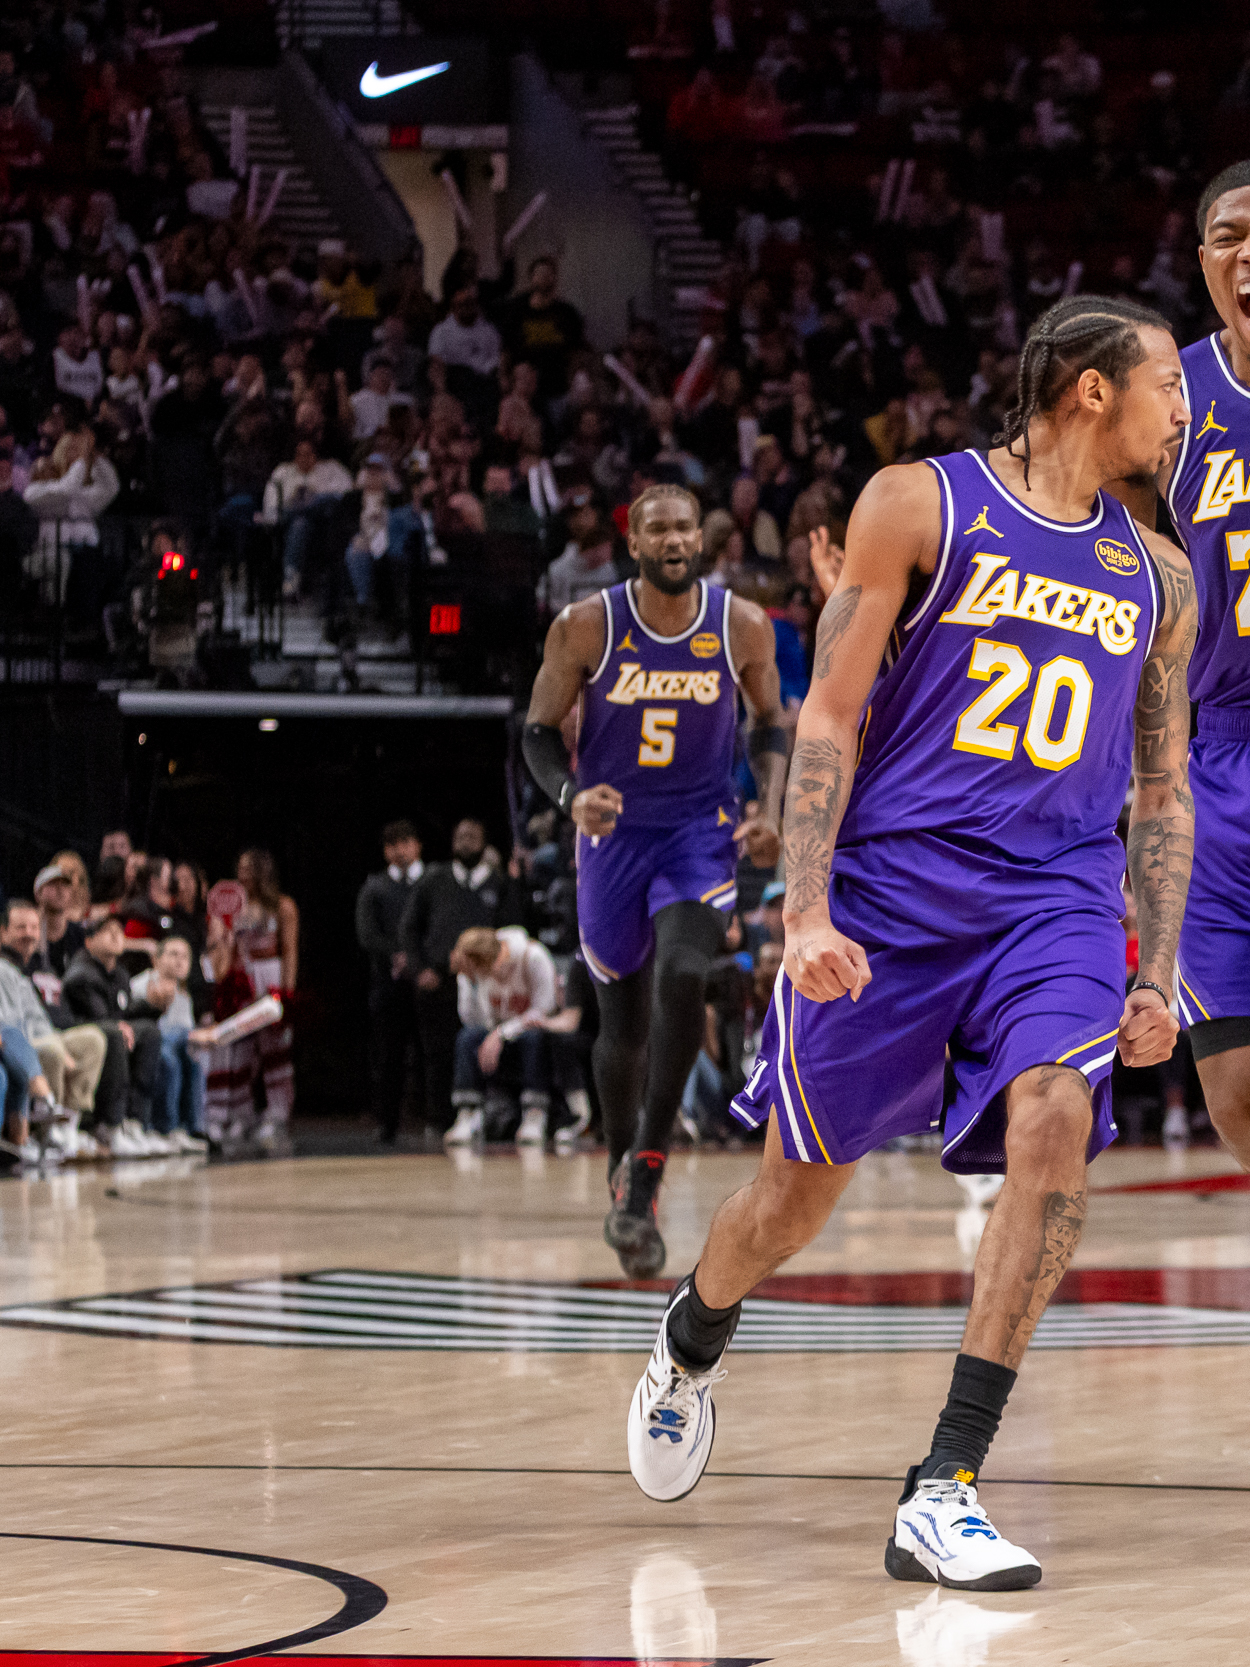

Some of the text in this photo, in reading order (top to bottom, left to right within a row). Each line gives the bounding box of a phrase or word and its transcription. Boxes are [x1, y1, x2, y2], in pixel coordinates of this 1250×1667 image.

[1098, 543, 1137, 567] bibigo
[938, 552, 1142, 656] LAKERS
[605, 662, 721, 706] LAKERS
[952, 637, 1094, 772] 20
[637, 707, 678, 768] 5
